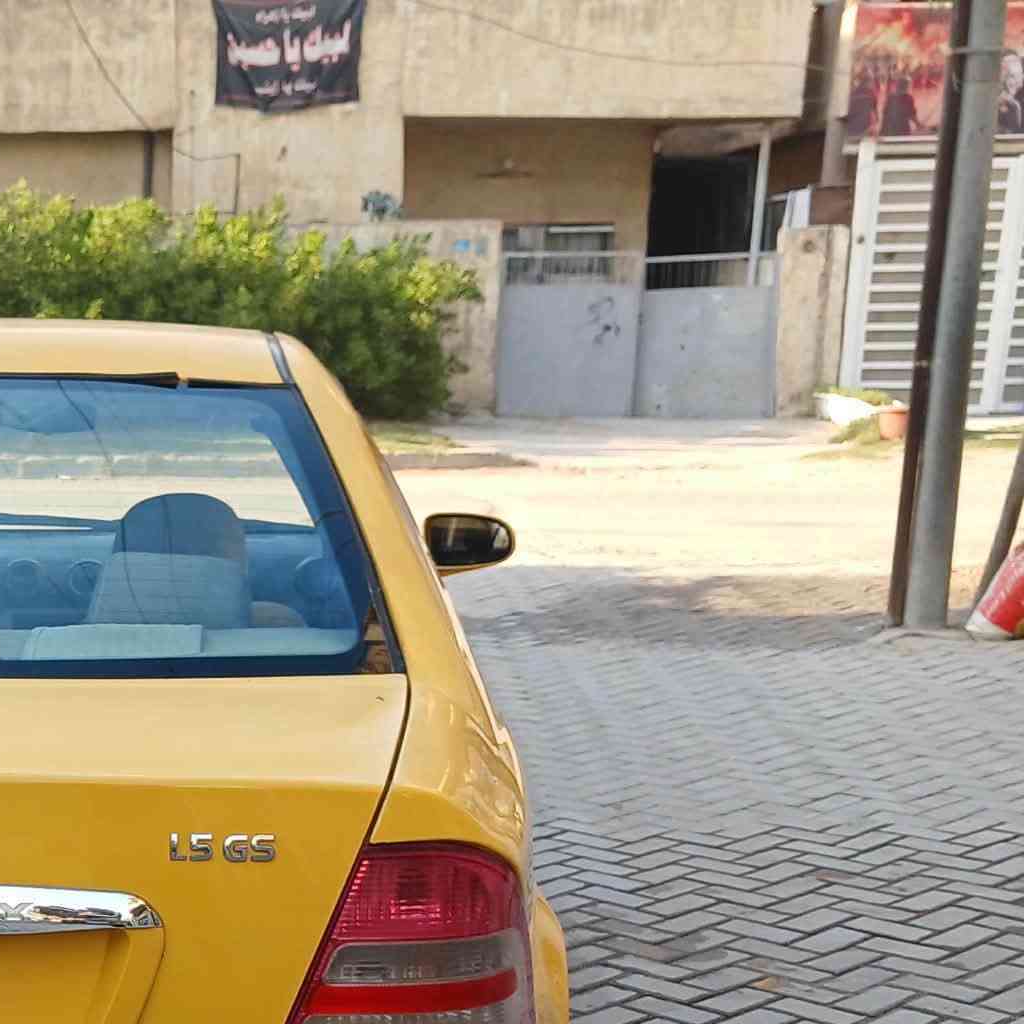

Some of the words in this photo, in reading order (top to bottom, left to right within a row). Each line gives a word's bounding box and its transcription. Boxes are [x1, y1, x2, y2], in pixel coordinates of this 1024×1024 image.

[283, 28, 301, 72] يا
[303, 19, 352, 63] لبيك
[223, 833, 276, 863] GS
